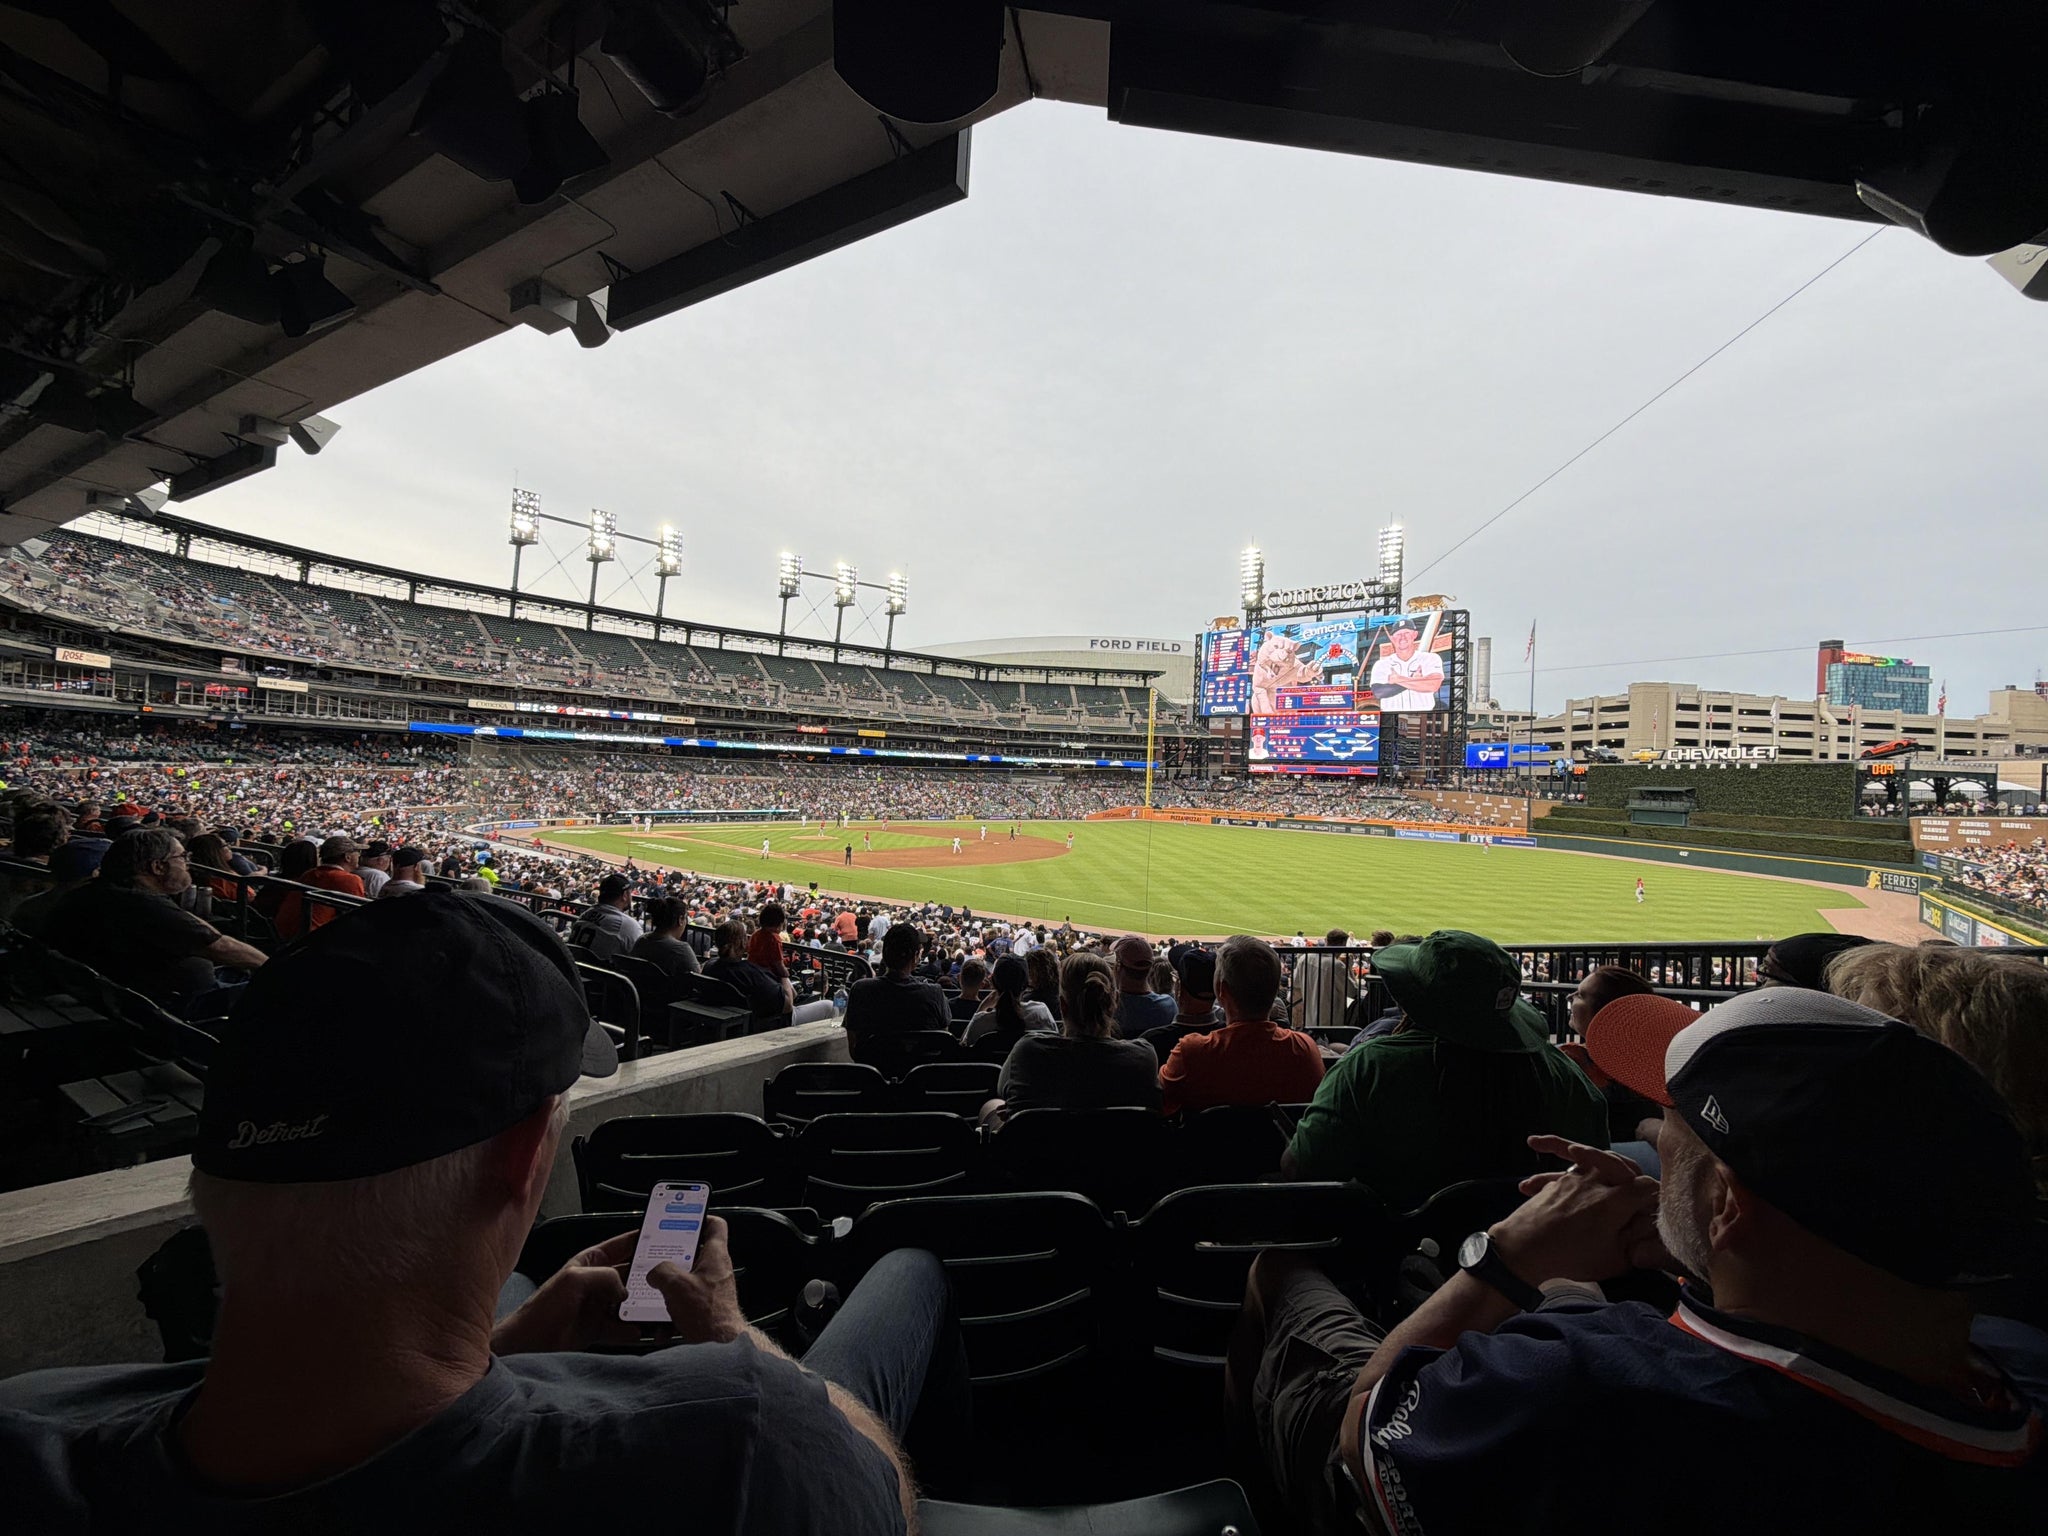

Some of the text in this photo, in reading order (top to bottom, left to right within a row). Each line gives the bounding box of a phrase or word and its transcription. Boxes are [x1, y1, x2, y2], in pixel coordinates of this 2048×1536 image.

[1090, 639, 1181, 652] FORD FIELD
[62, 650, 84, 660] ROSE
[1667, 746, 1779, 760] CHEVROLET
[1872, 763, 1895, 775] 0:09
[2001, 822, 2032, 830] HARWELL
[1469, 834, 1493, 844] DTE
[1882, 873, 1918, 889] FERRIS
[227, 1113, 330, 1150] Detroit
[1370, 1379, 1421, 1451] Bally
